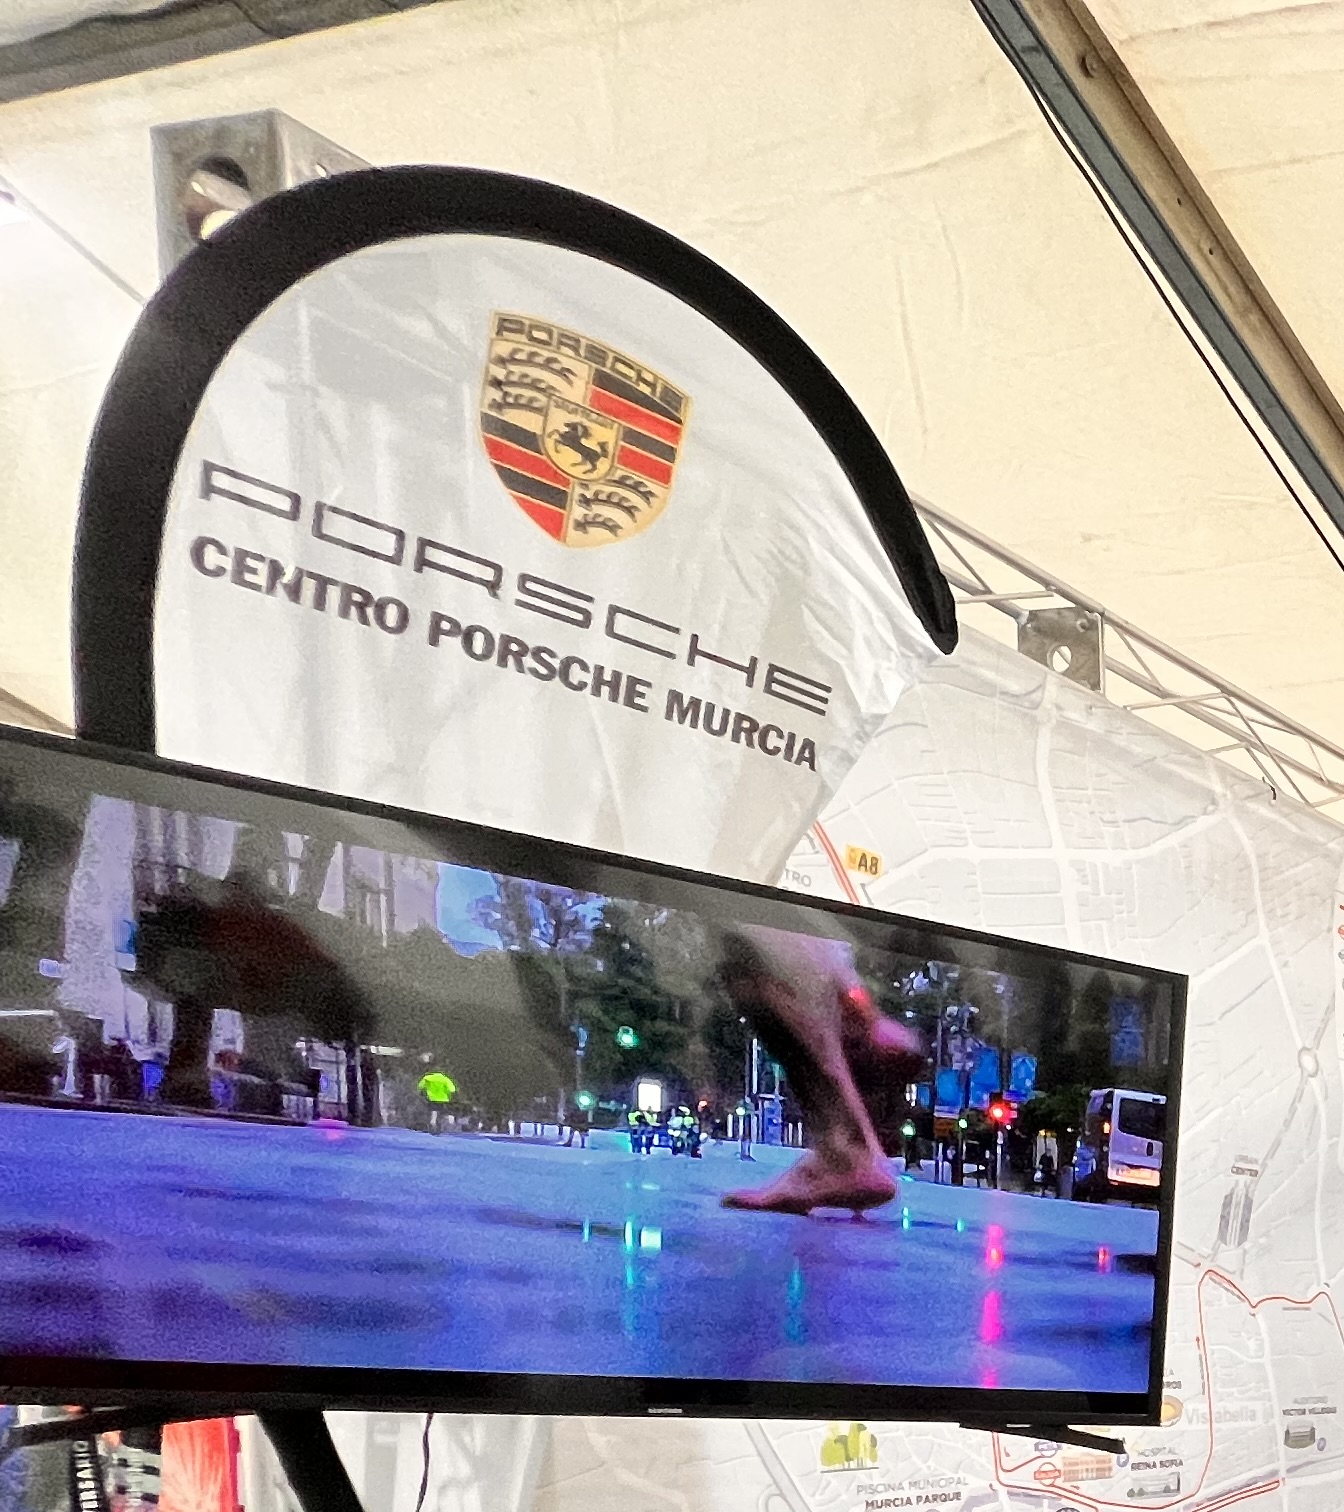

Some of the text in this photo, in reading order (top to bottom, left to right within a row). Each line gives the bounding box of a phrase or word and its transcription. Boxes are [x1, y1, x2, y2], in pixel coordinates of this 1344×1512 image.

[495, 317, 683, 414] PORSCHE
[201, 461, 832, 717] PORSCHE
[190, 536, 819, 772] CENTRO PORSCHE MURCIA
[856, 1476, 969, 1495] PISCINA MUNICIPAL
[864, 1491, 962, 1511] MURCIA PARQUE
